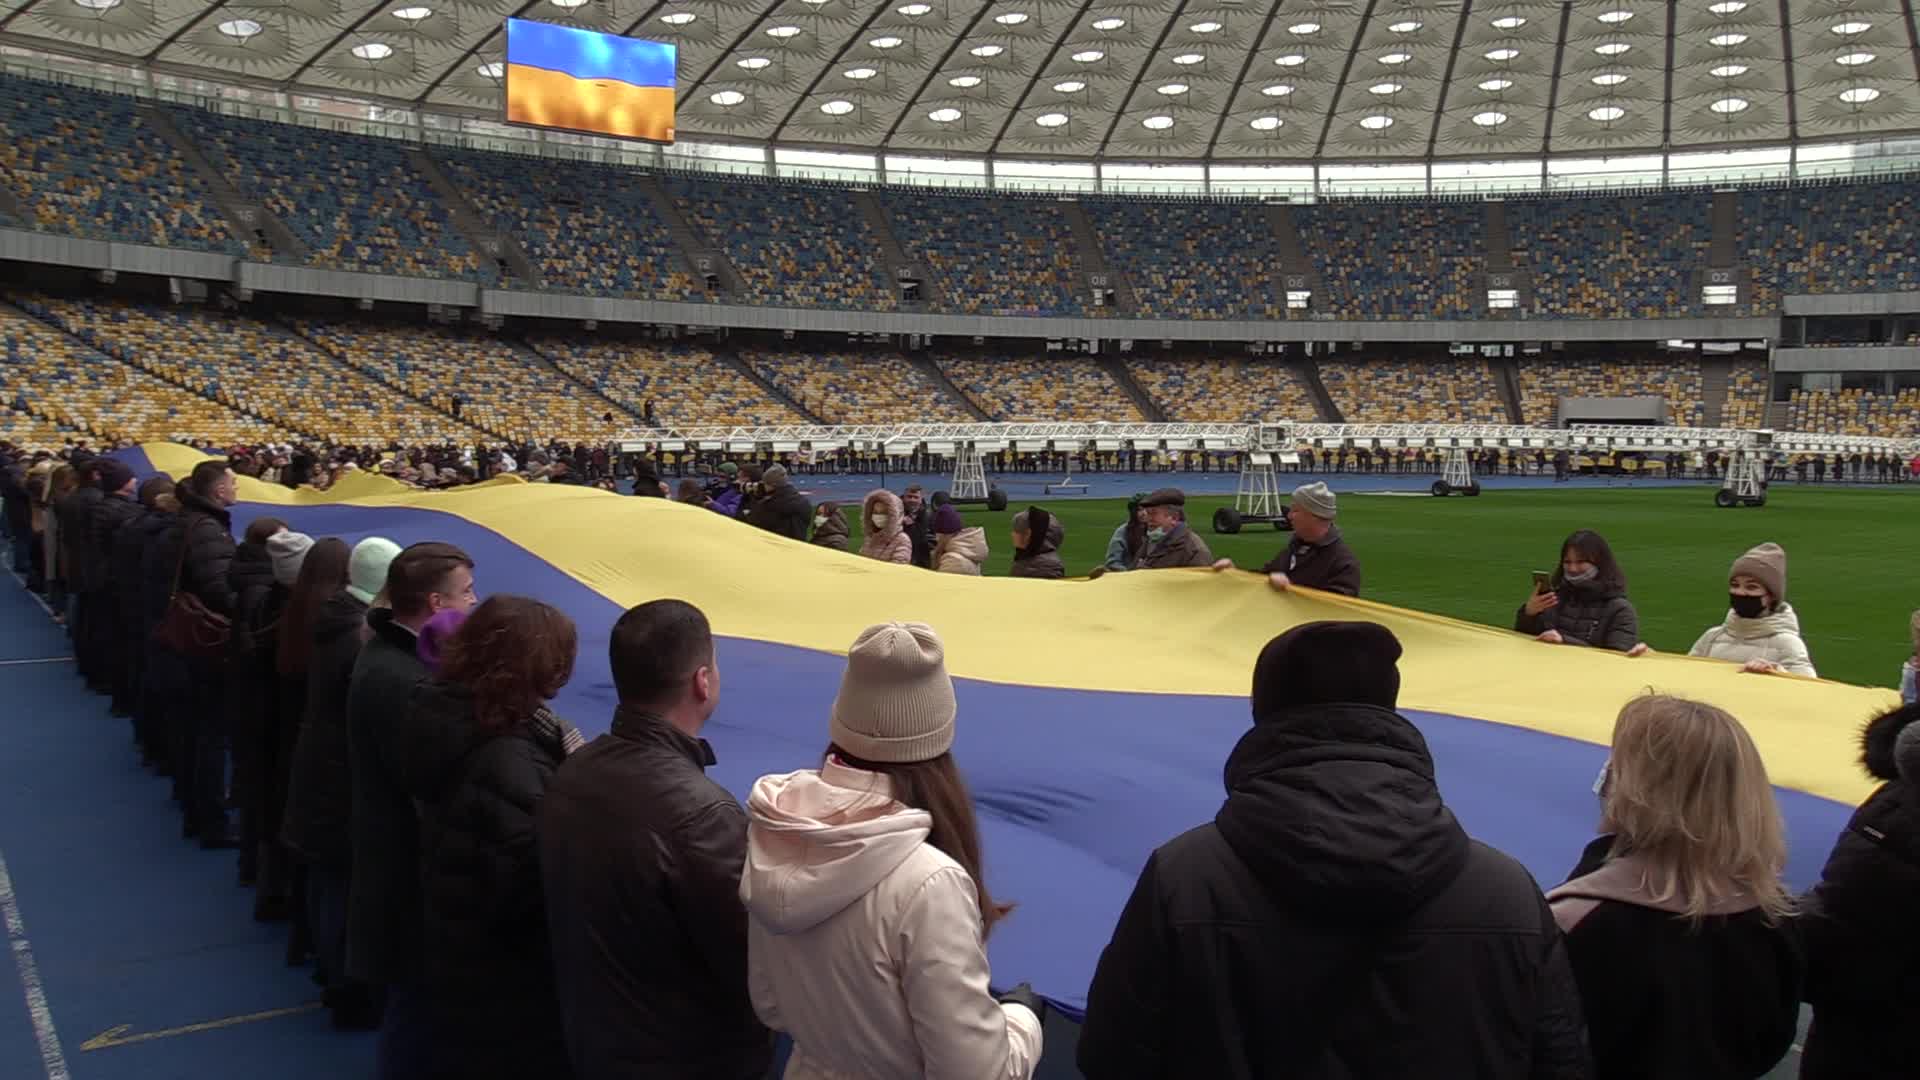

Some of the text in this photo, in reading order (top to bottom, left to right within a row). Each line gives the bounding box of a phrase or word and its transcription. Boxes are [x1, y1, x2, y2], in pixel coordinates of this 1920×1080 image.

[897, 269, 911, 278] 10
[1711, 272, 1728, 283] 02
[1287, 278, 1303, 288] 06
